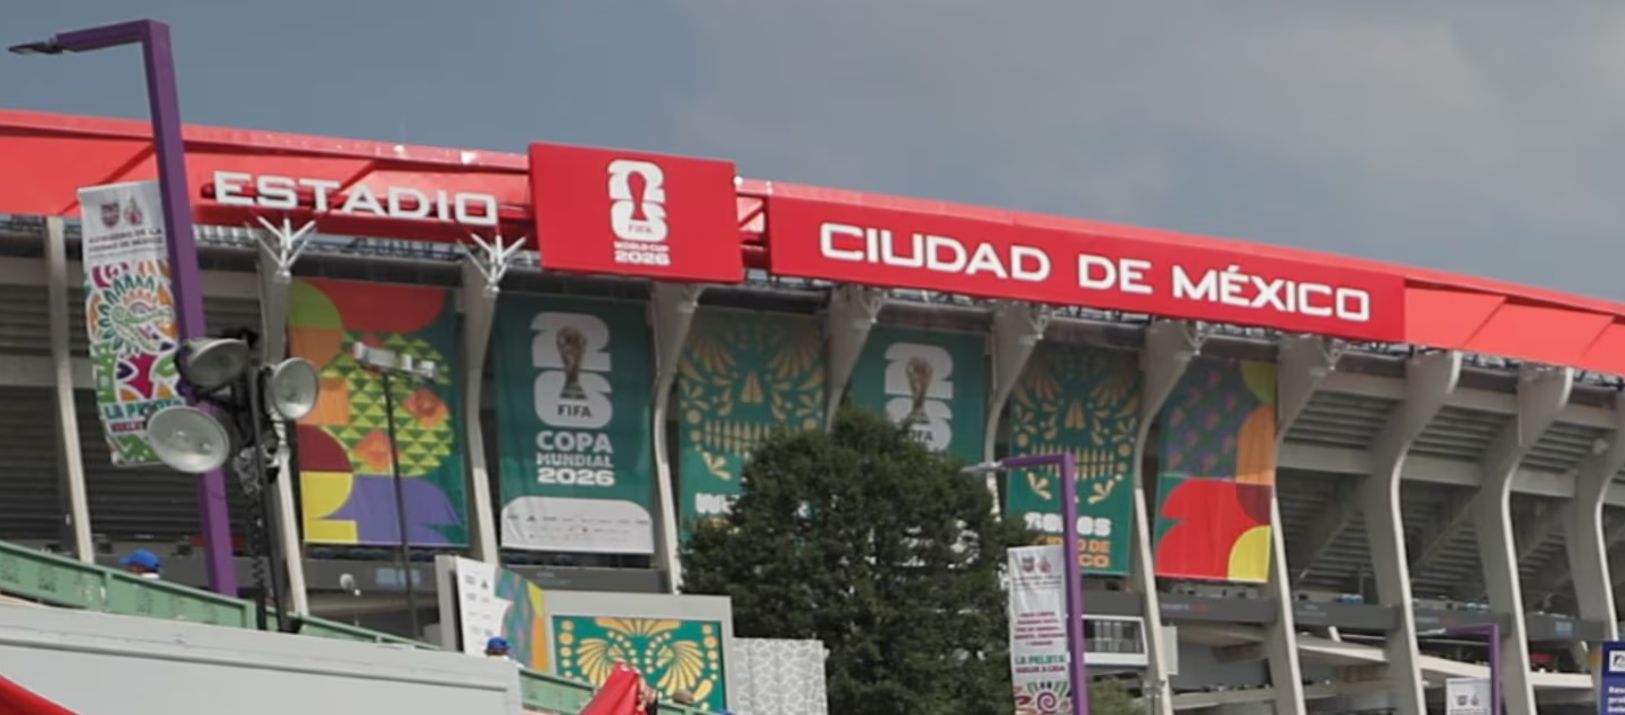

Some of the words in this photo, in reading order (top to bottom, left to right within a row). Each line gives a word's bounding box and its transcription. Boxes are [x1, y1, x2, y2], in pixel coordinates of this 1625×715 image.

[213, 171, 498, 225] ESTADIO
[628, 225, 652, 233] FIFA
[614, 250, 671, 266] 2026
[819, 222, 1051, 283] CIUDAD
[1078, 253, 1152, 294] DE
[1172, 264, 1370, 322] MÉXICO
[104, 405, 124, 419] LA
[557, 404, 592, 417] FIFA
[536, 429, 614, 455] COPA
[536, 451, 615, 468] MUNDIAL
[537, 467, 615, 487] 2026
